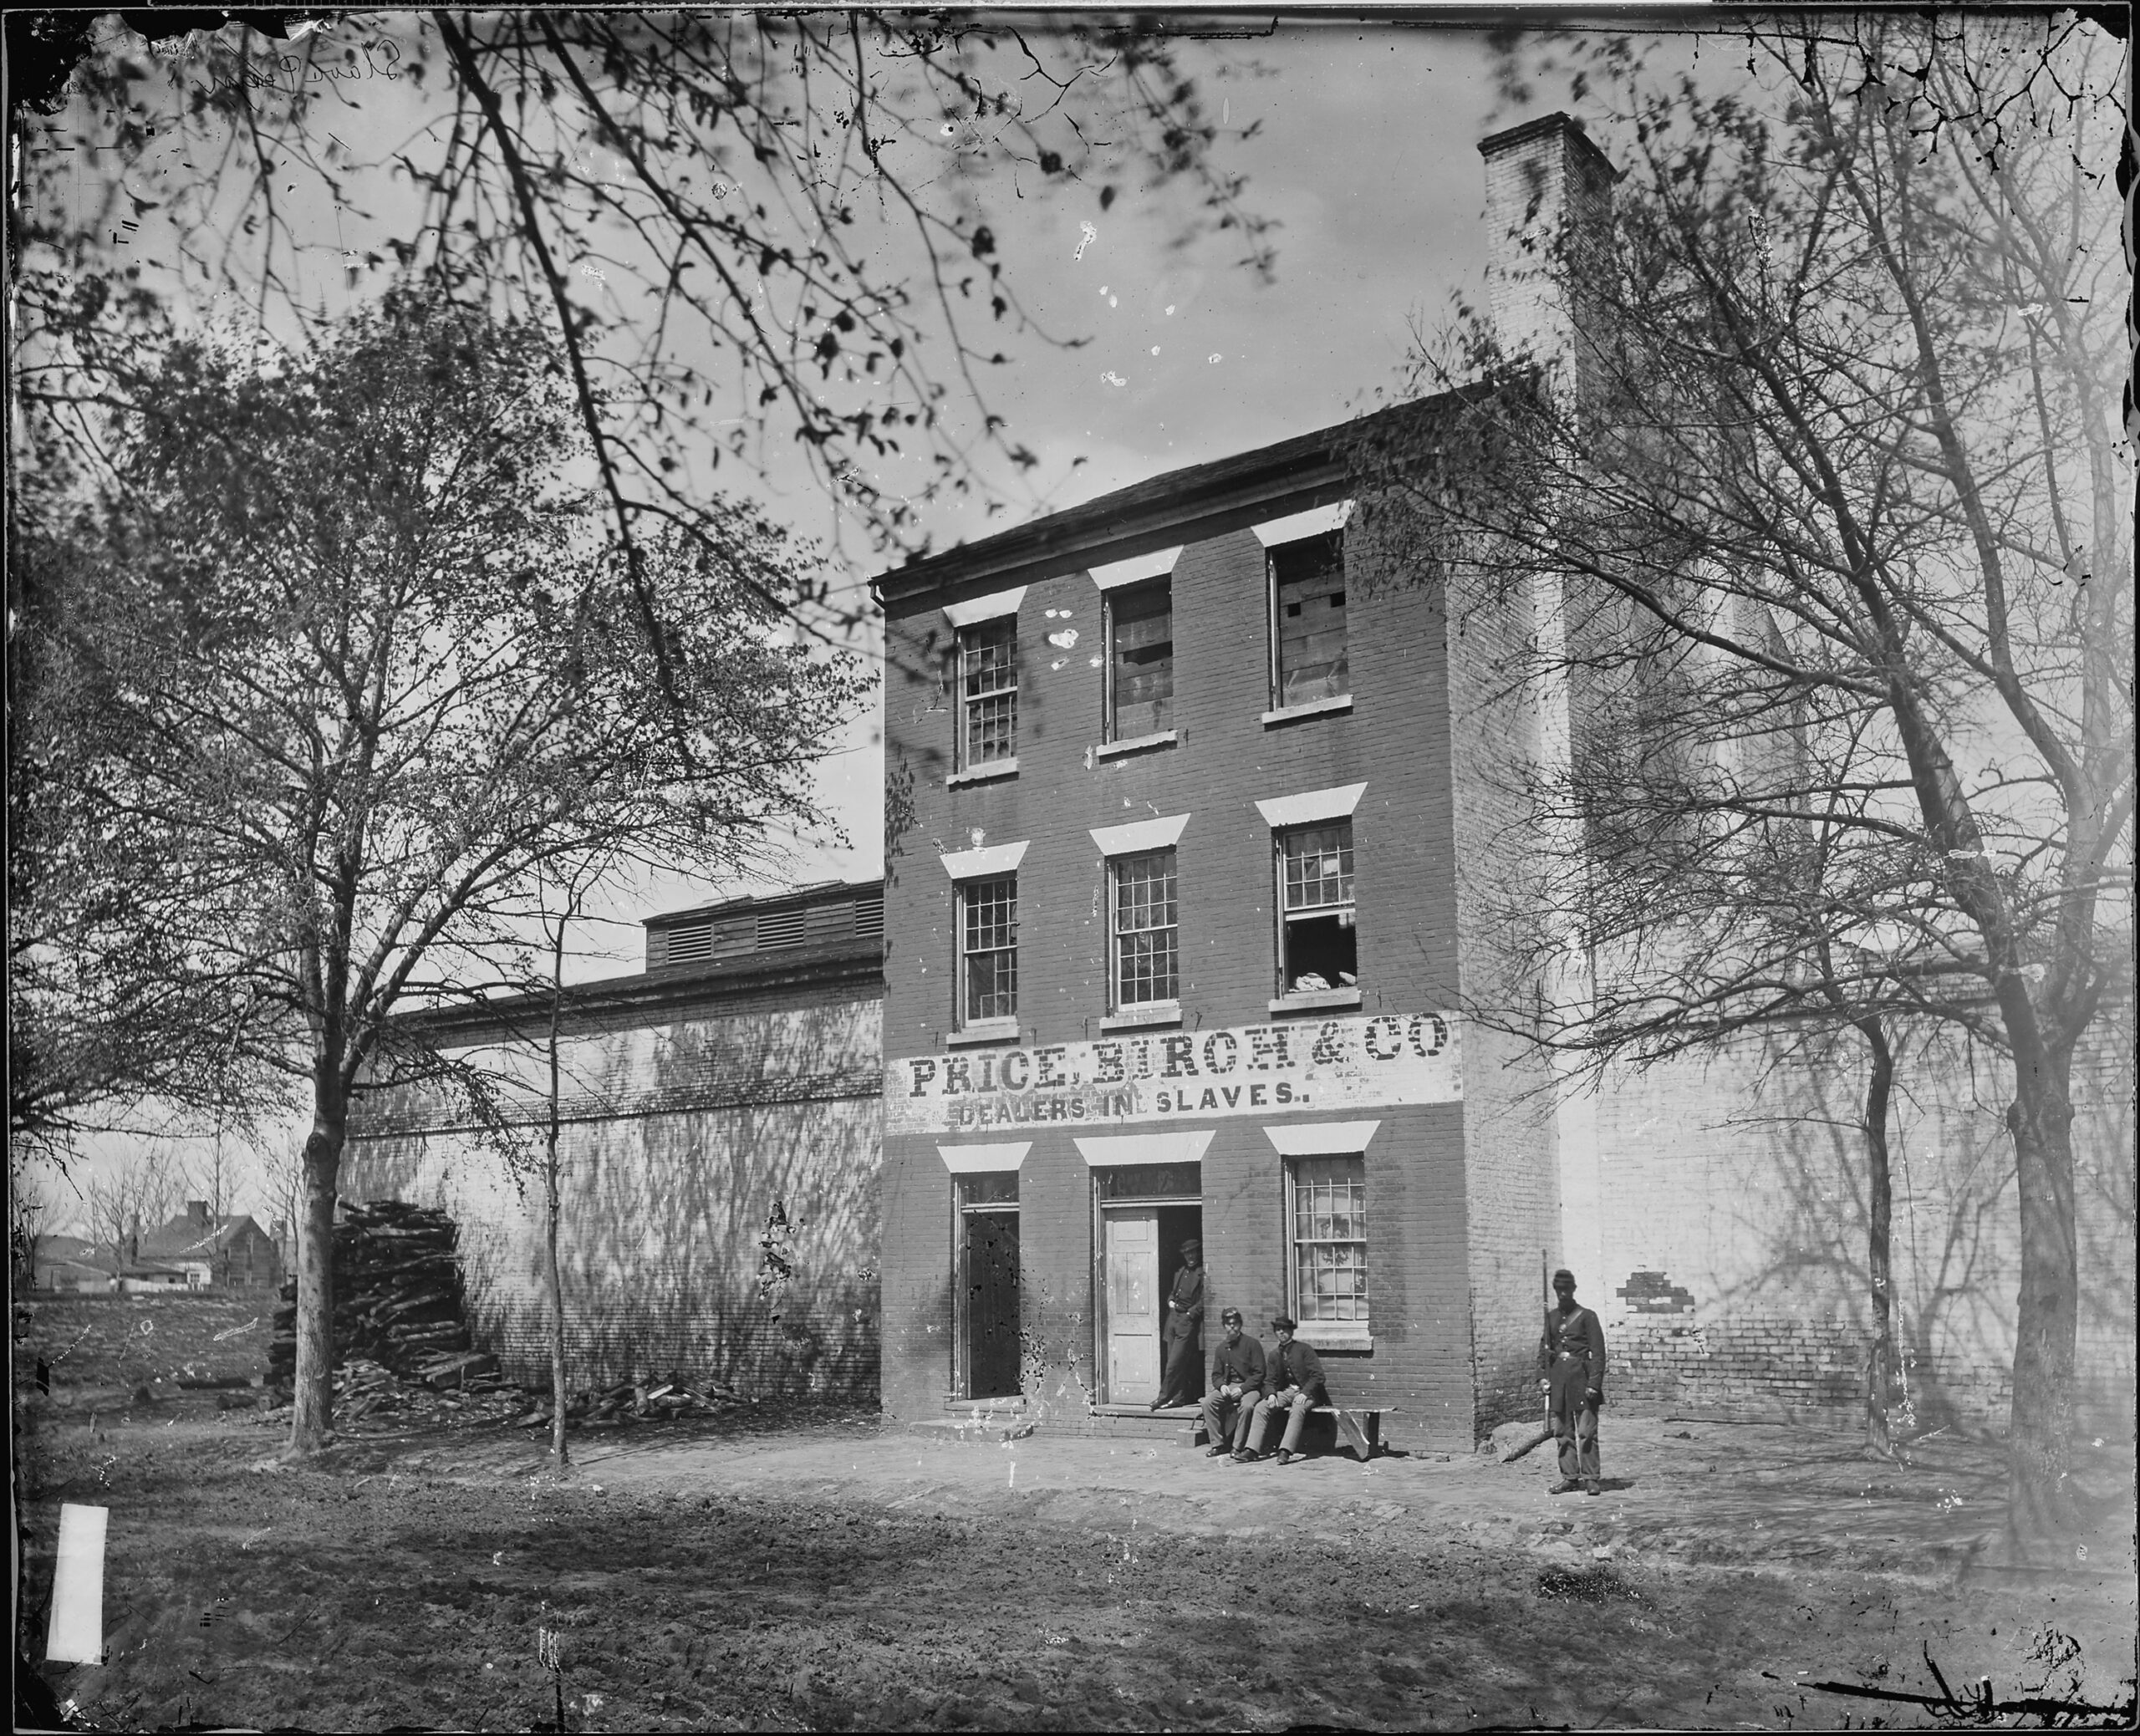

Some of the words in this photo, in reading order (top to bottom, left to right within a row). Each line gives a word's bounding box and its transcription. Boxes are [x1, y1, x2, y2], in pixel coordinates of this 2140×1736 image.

[1092, 1026, 1296, 1084] BIRCH
[1311, 1021, 1350, 1066] &
[1364, 1012, 1449, 1061] CO
[959, 1097, 1085, 1126] DEALERS
[1103, 1093, 1134, 1117] IN
